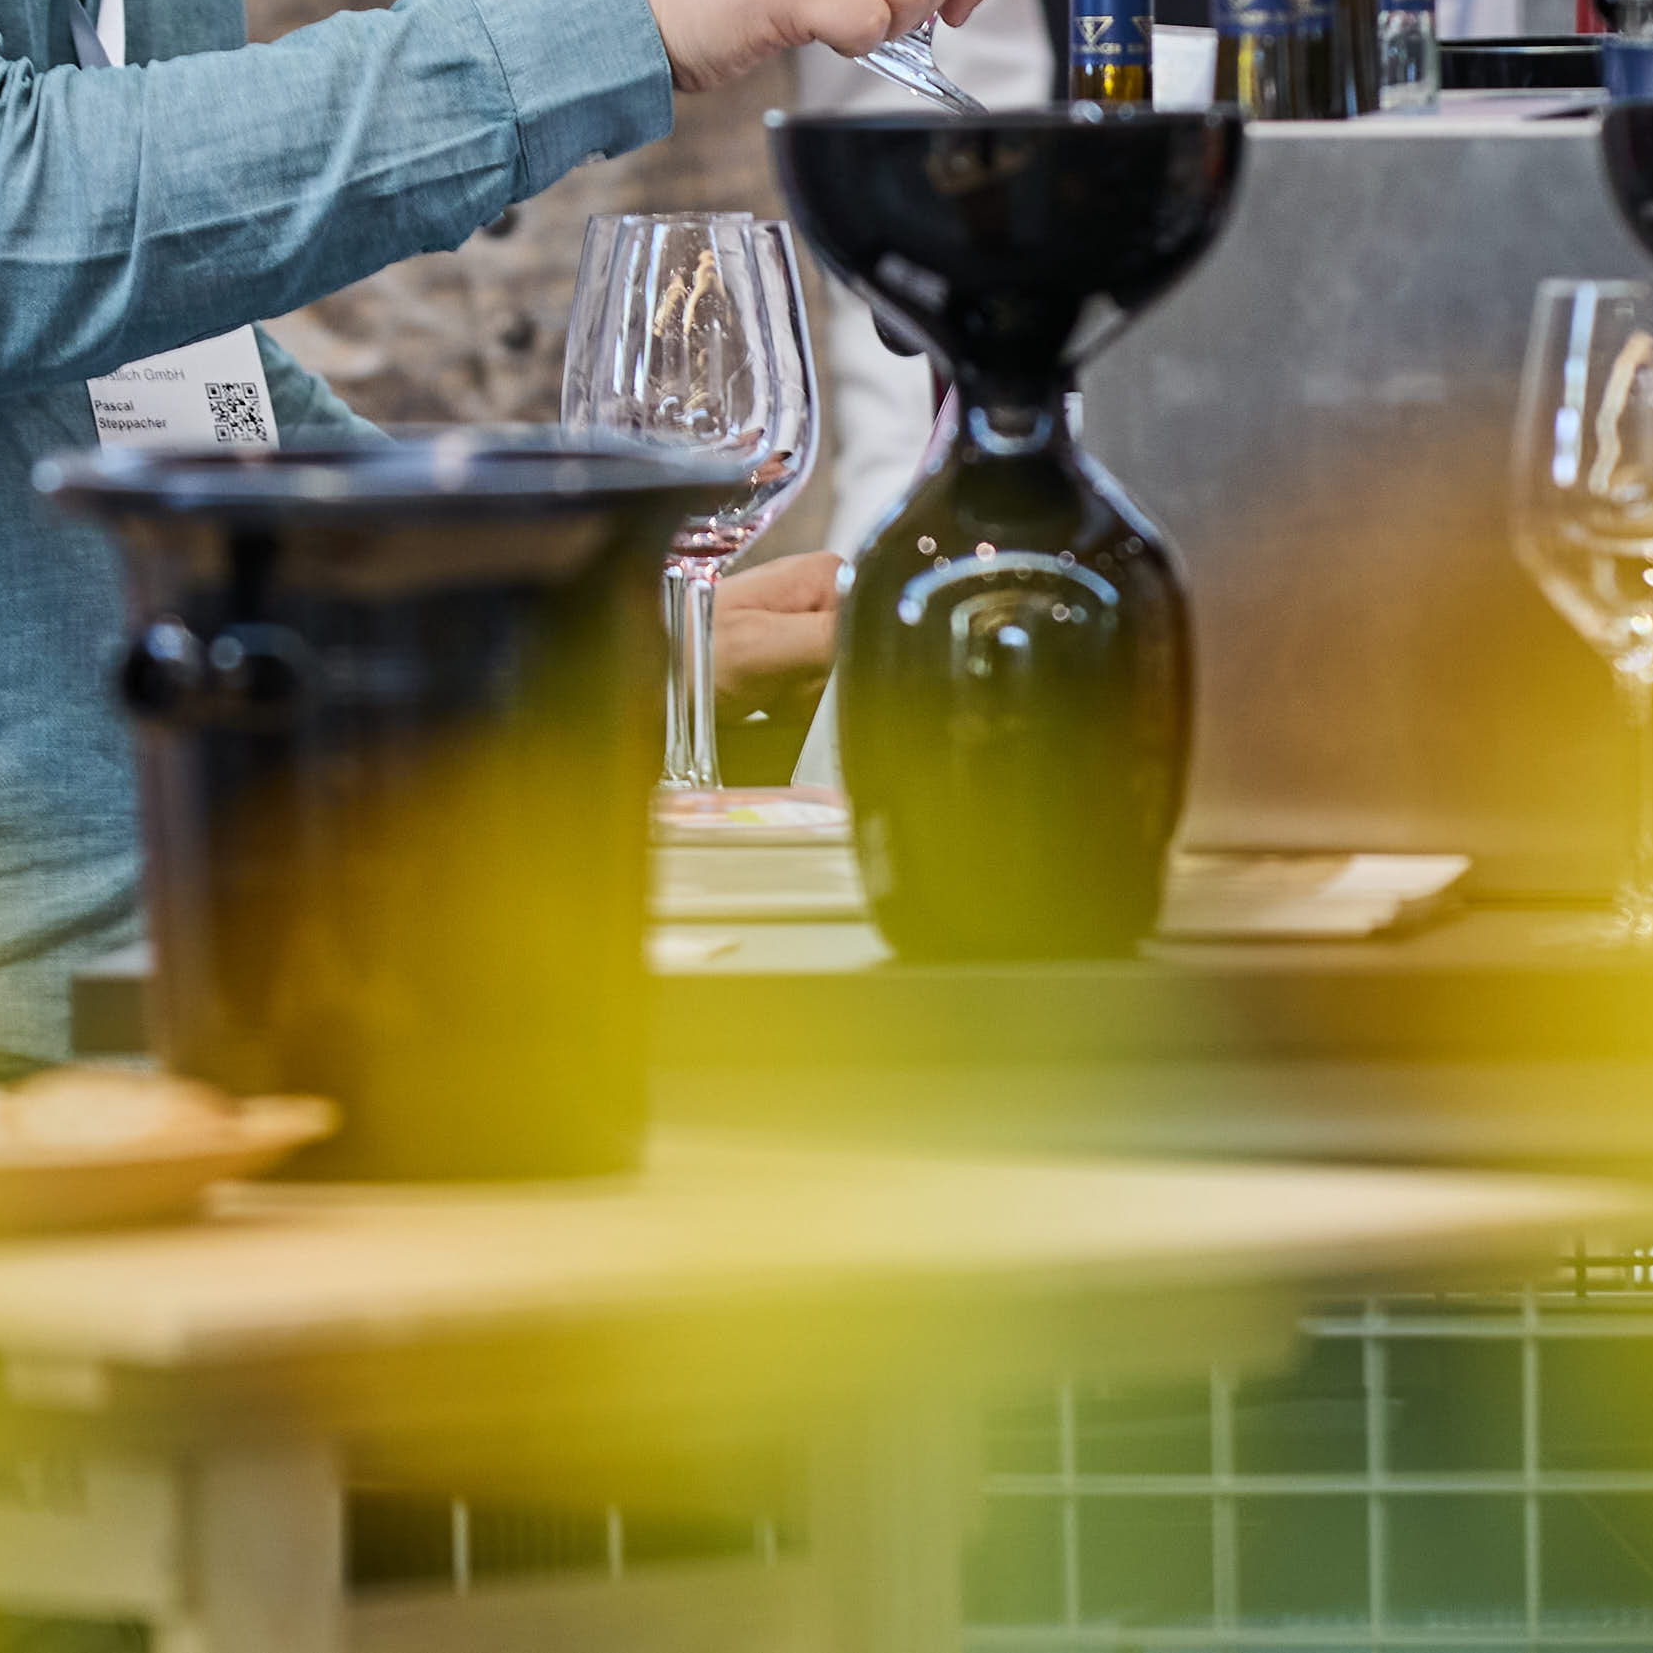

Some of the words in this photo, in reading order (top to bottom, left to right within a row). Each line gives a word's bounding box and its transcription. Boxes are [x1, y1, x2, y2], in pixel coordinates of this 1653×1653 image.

[144, 368, 186, 382] GmbH
[93, 399, 135, 412] Pascal
[98, 416, 167, 432] Steppacher
